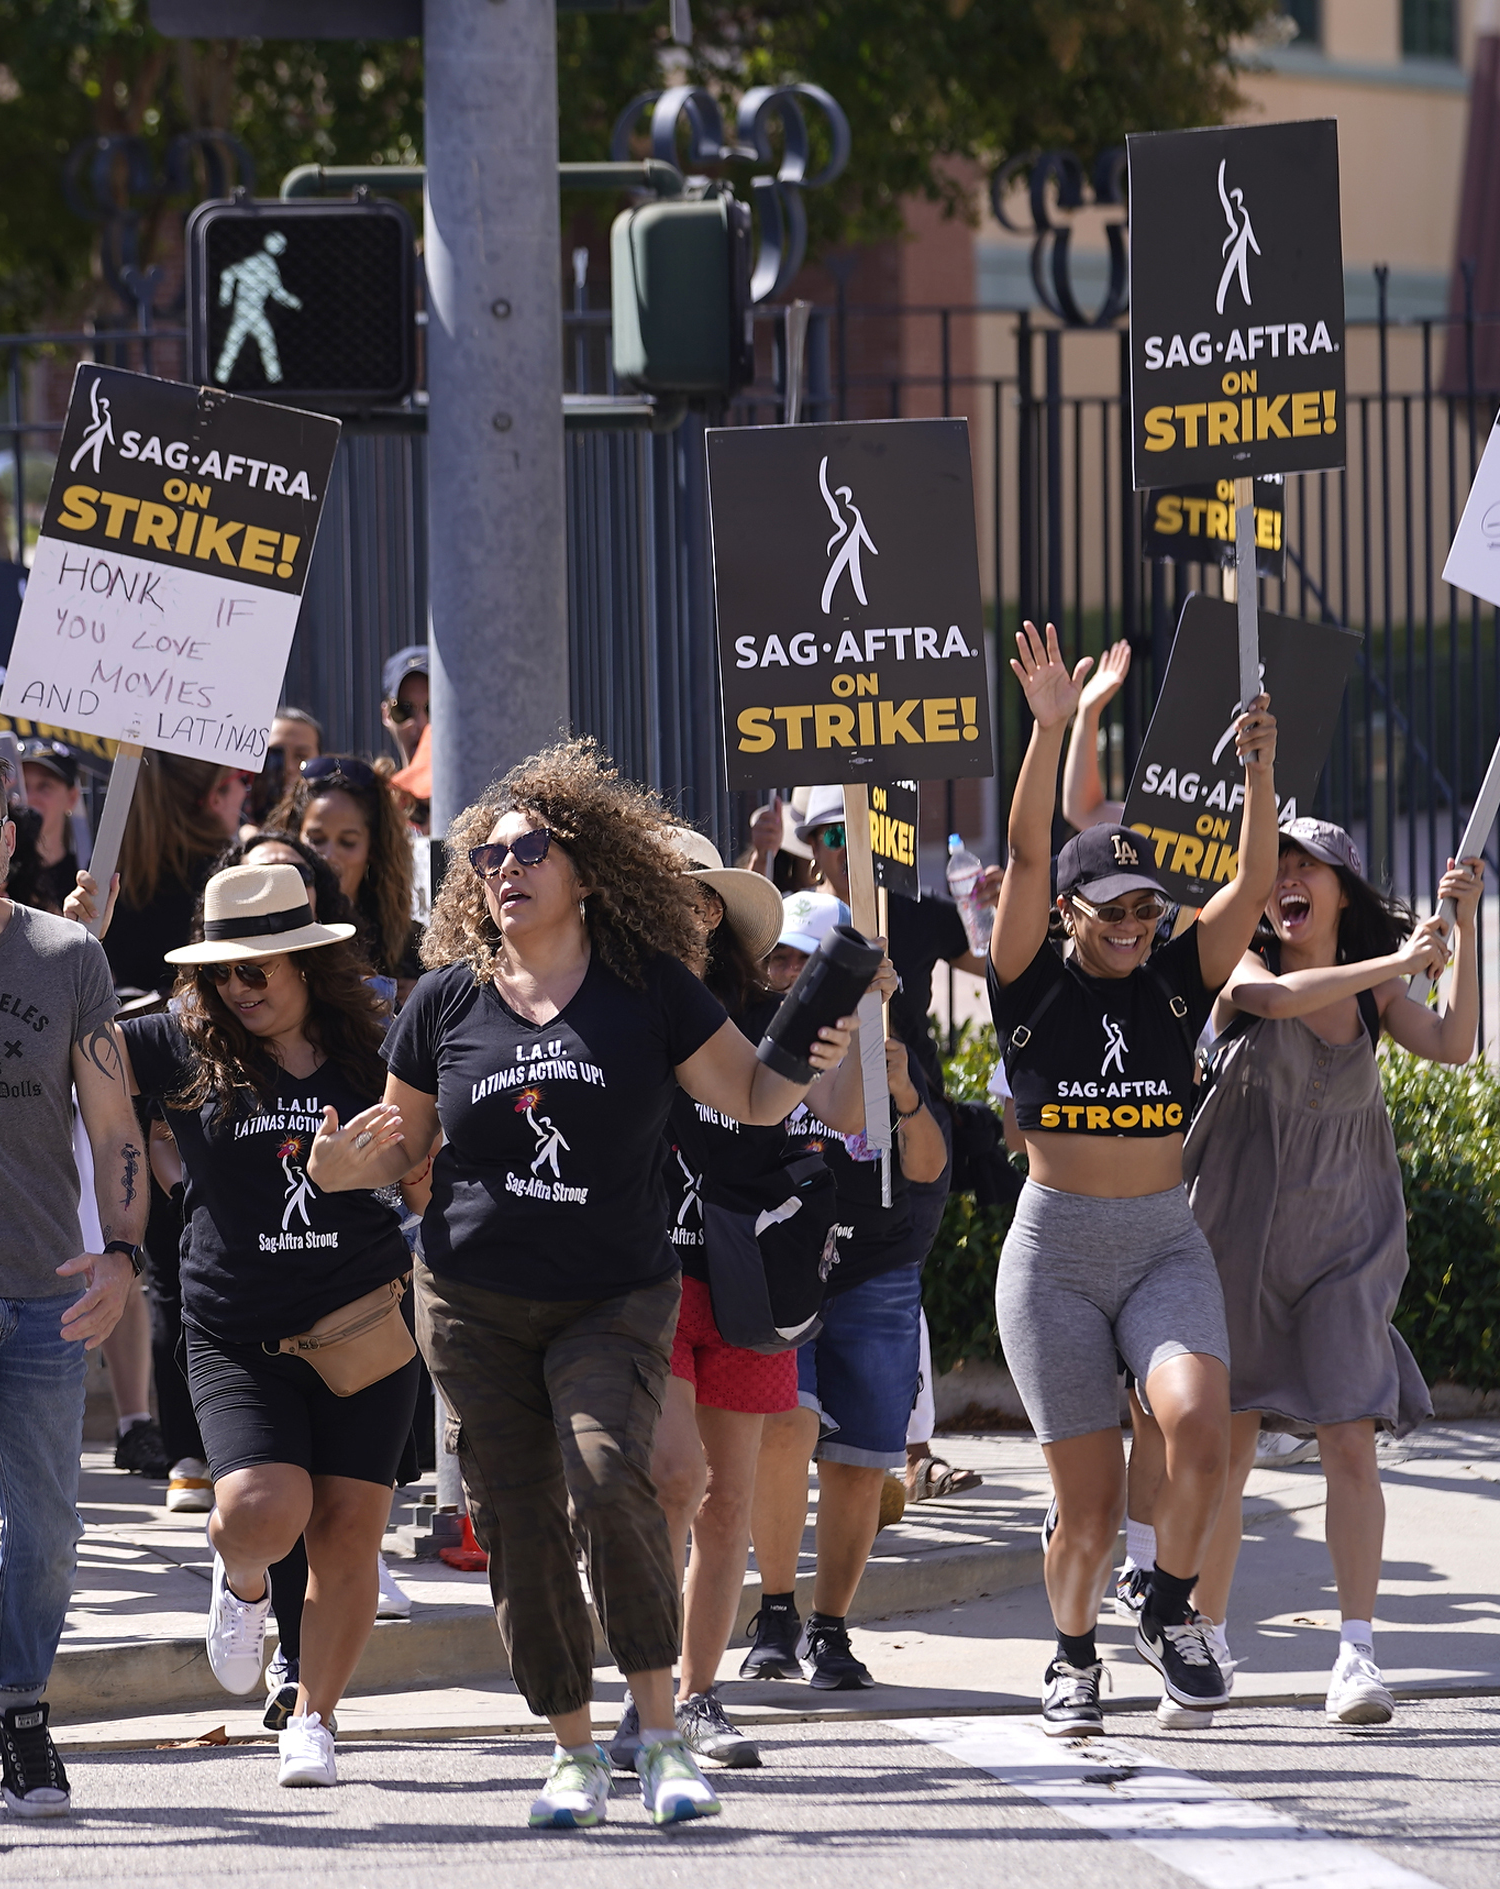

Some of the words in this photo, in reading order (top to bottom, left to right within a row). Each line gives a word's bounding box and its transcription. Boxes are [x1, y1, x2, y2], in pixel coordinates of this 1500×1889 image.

[1221, 370, 1257, 396] ON
[1144, 389, 1338, 452] STRIKE!
[163, 479, 212, 509] ON
[57, 485, 300, 579] STRIKE!
[1154, 494, 1282, 552] STRIE!
[58, 552, 164, 612] HONK
[216, 597, 257, 629] IF
[56, 608, 105, 644] YOU
[131, 631, 211, 661] LOVE
[20, 681, 100, 716] AND
[90, 659, 216, 709] MOVIES
[831, 673, 879, 698] ON
[737, 696, 980, 754] STRIKE!
[873, 786, 887, 812] ON
[1196, 814, 1231, 841] ON
[1110, 834, 1139, 866] LA
[516, 1040, 567, 1062] L.A.U.
[471, 1066, 524, 1105] LATINAS
[528, 1060, 578, 1082] ACTING
[579, 1061, 606, 1088] UP!
[277, 1097, 322, 1113] L.A.U.
[1040, 1103, 1183, 1130] STRONG
[234, 1114, 285, 1141] LATINAS
[287, 1113, 322, 1133] ACTIN
[505, 1171, 551, 1201] Sag-Aftra
[552, 1181, 589, 1205] Strong
[258, 1232, 303, 1253] Sag-Aftra
[305, 1231, 339, 1249] Strong
